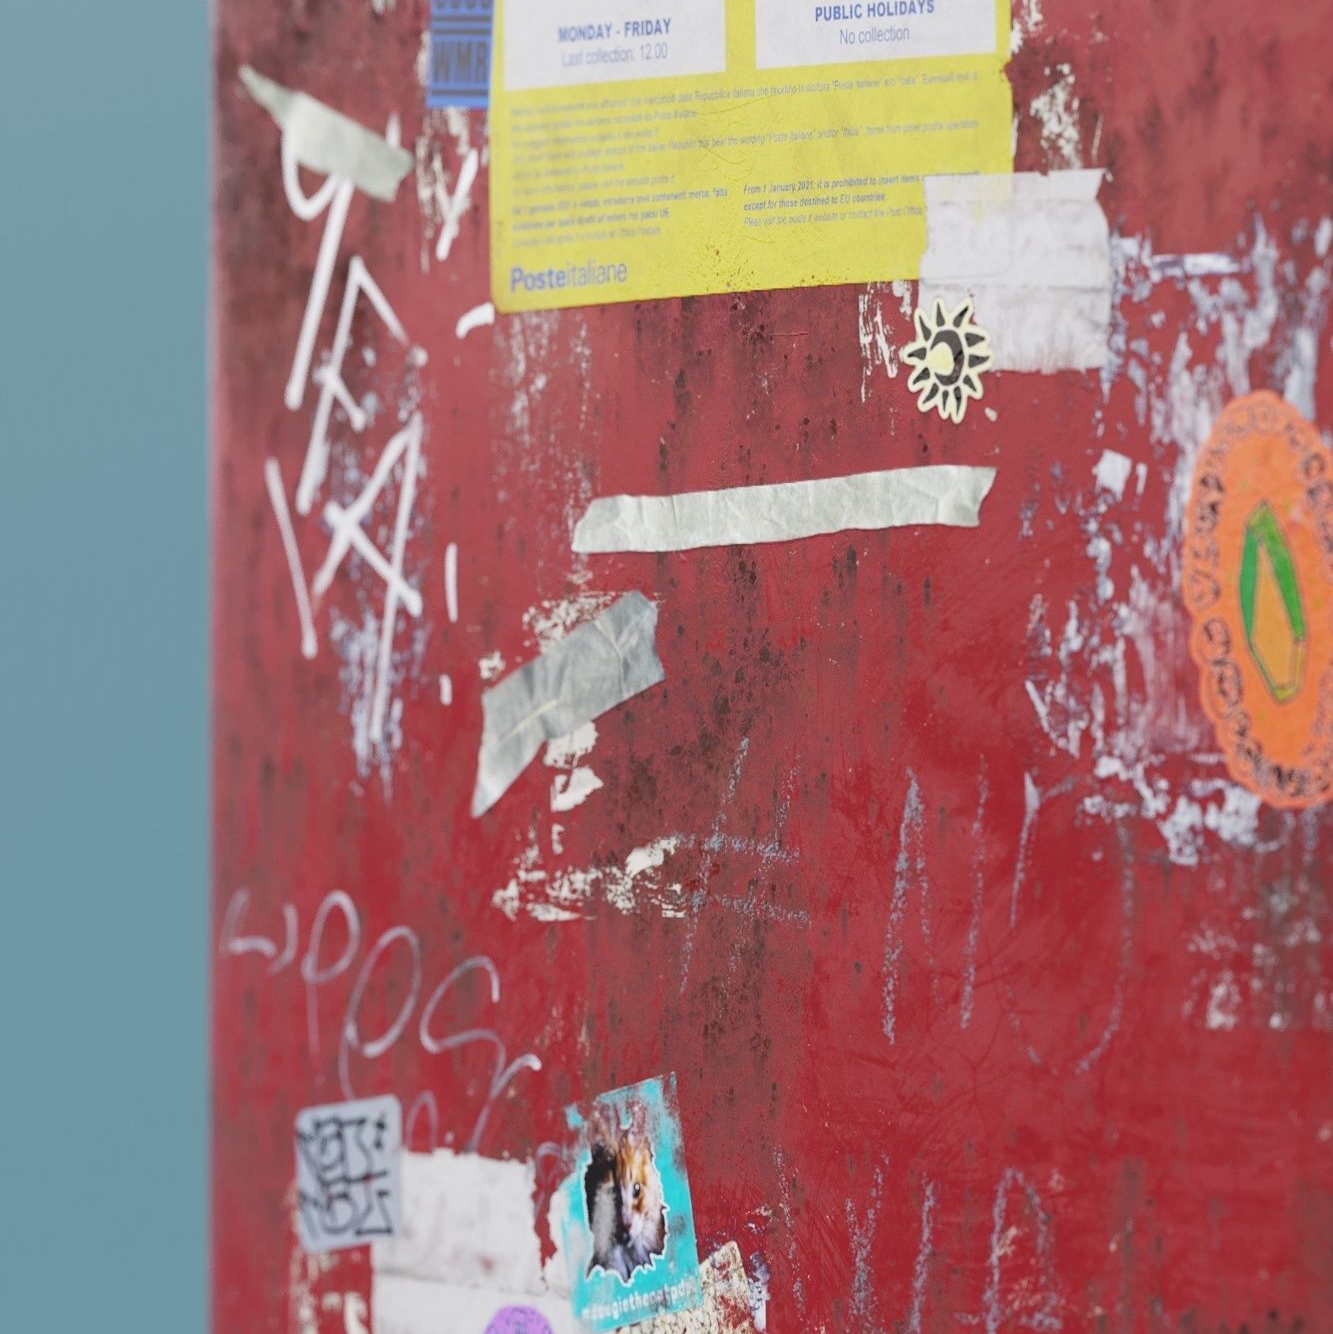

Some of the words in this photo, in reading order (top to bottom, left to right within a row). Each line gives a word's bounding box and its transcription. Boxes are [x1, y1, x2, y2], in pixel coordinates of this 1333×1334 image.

[815, 3, 863, 22] PUBLIC
[558, 23, 613, 42] MONDAY
[624, 18, 672, 37] FRIDAY
[840, 28, 856, 45] No
[859, 25, 910, 44] collection
[561, 51, 583, 67] Last
[640, 42, 668, 60] 12.00
[510, 259, 628, 293] Posteitaliane
